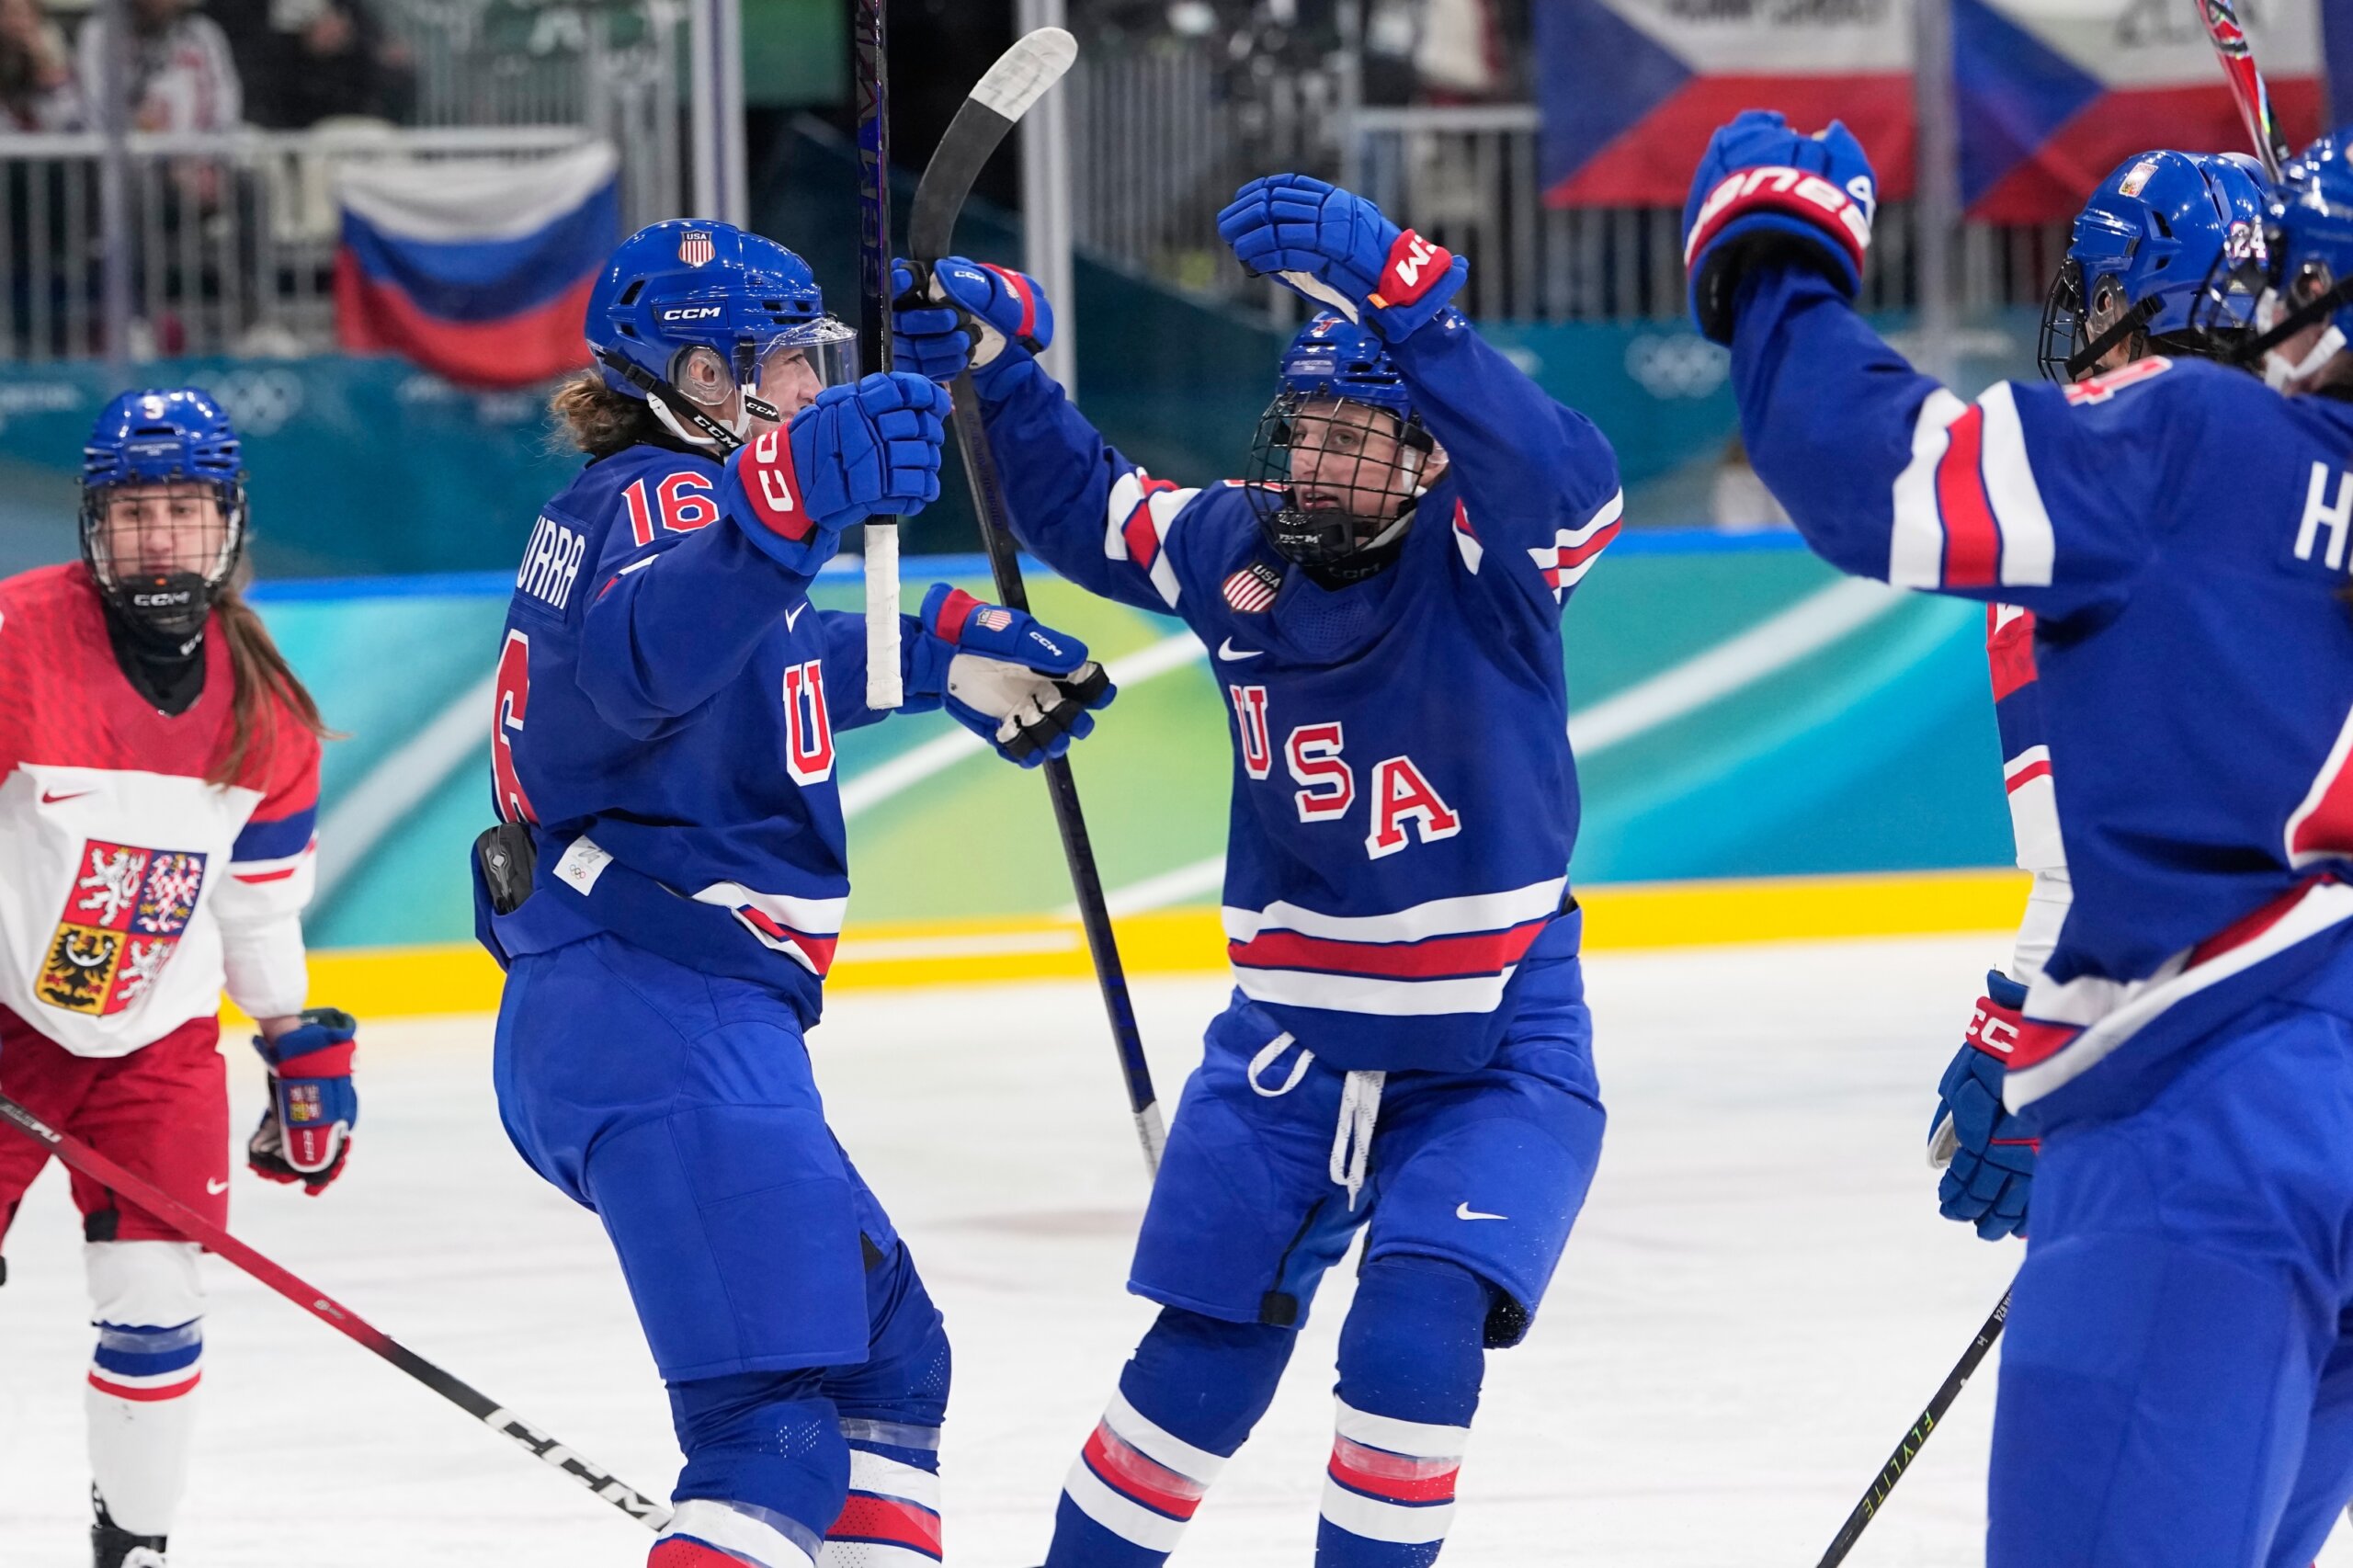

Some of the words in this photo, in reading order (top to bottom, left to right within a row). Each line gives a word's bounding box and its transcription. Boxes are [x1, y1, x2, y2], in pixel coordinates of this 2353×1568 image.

[686, 233, 708, 241] USA
[2230, 222, 2268, 259] 24
[1395, 233, 1438, 287] M
[664, 306, 722, 321] CCM
[142, 395, 165, 420] 3
[745, 401, 778, 417] CCM
[693, 414, 740, 449] CCM
[621, 471, 720, 548] 16
[2294, 460, 2353, 576] H
[1252, 563, 1282, 589] USA
[1029, 631, 1063, 657] CCM
[1229, 684, 1462, 861] USA
[483, 1407, 674, 1532] CCM
[1862, 1409, 1934, 1519] FLYLITE
